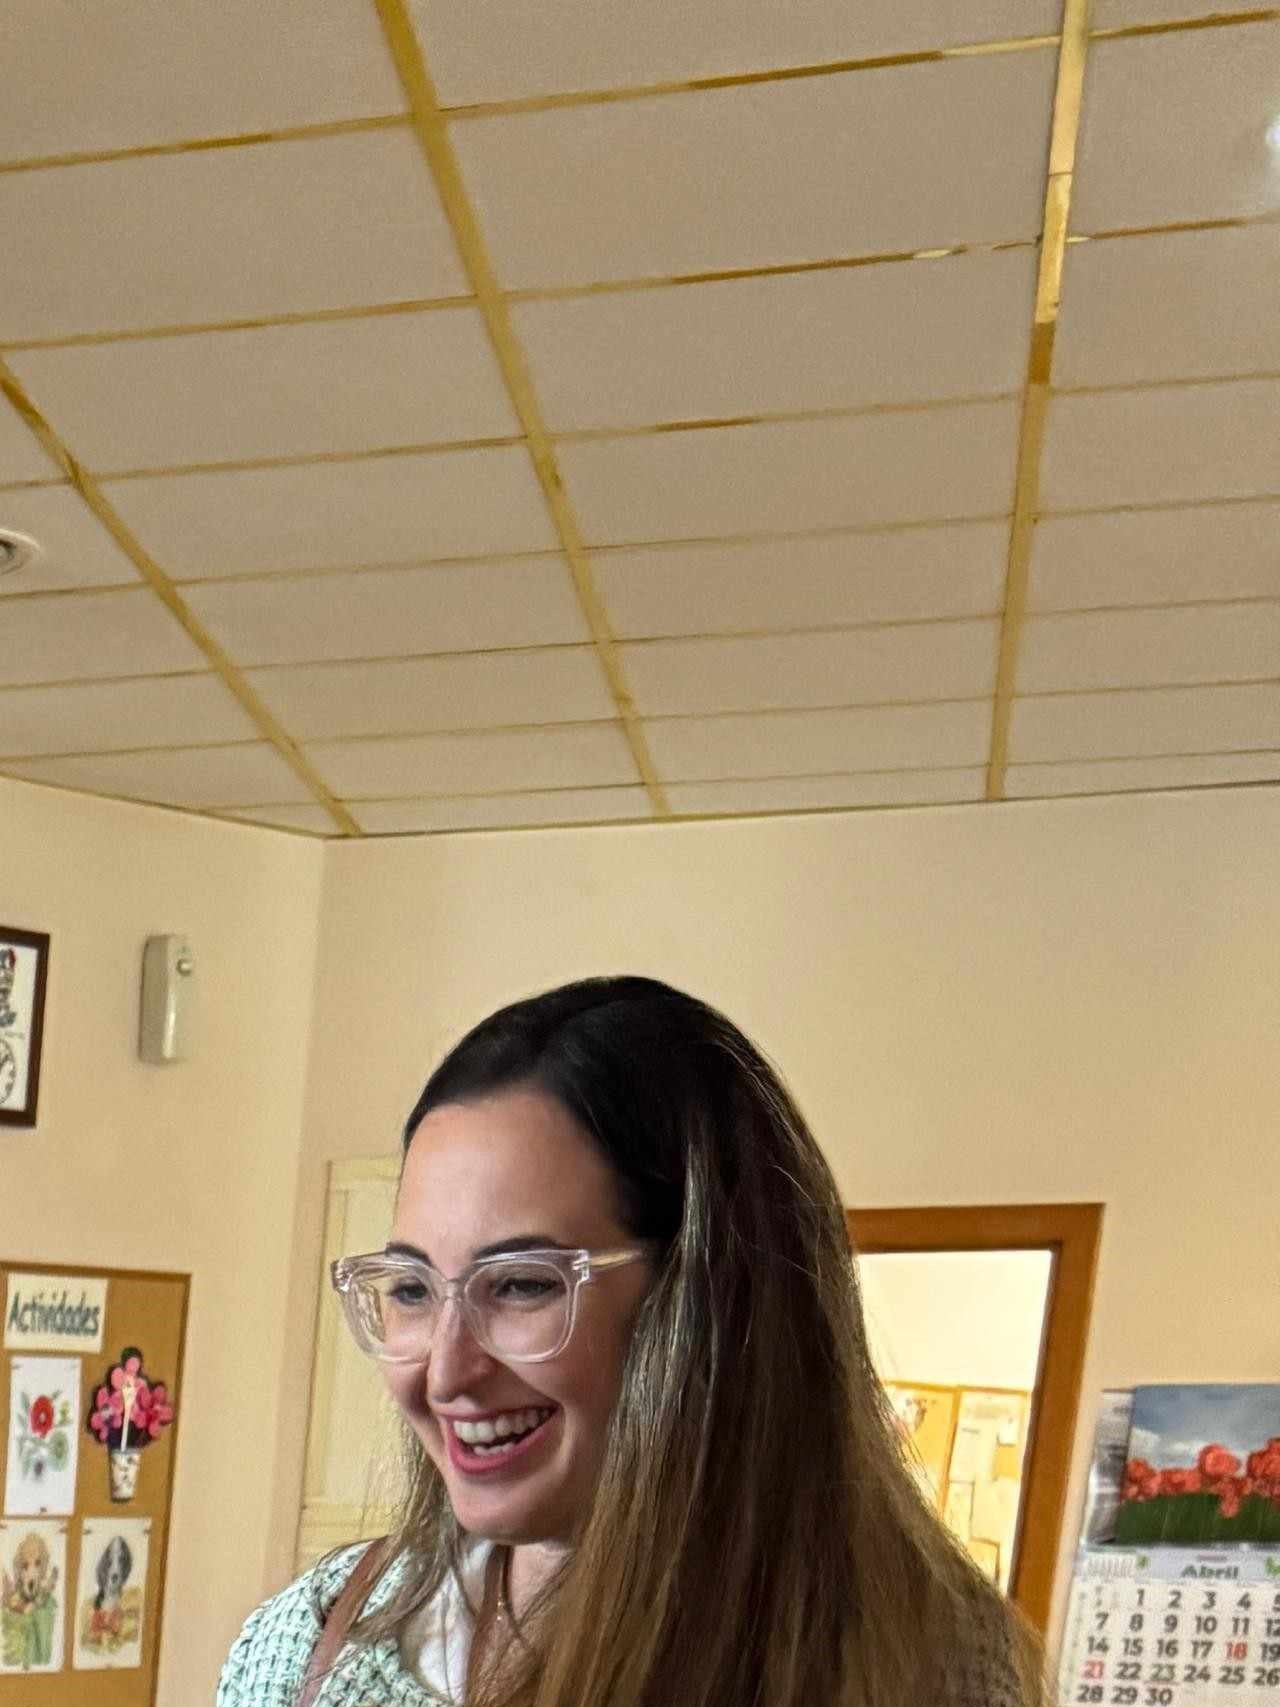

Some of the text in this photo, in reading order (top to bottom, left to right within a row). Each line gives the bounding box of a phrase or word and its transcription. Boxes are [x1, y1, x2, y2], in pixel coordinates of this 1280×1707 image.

[7, 1291, 101, 1338] Actividades
[1181, 1565, 1239, 1579] Abril
[1137, 1588, 1145, 1607] 1
[1168, 1590, 1182, 1609] 2
[1203, 1592, 1216, 1610] 3
[1237, 1593, 1252, 1611] 4
[1095, 1612, 1109, 1631] 7
[1129, 1613, 1144, 1632] 8
[1164, 1614, 1179, 1633] 9
[1196, 1616, 1218, 1634] 10
[1232, 1617, 1250, 1636] 11
[1088, 1636, 1109, 1654] 14
[1122, 1637, 1144, 1656] 15
[1156, 1639, 1179, 1656] 16
[1191, 1640, 1214, 1659] 17
[1226, 1641, 1248, 1661] 18
[1082, 1660, 1280, 1687] 21 22 23 24 25 26
[1077, 1685, 1174, 1706] 28 29 30
